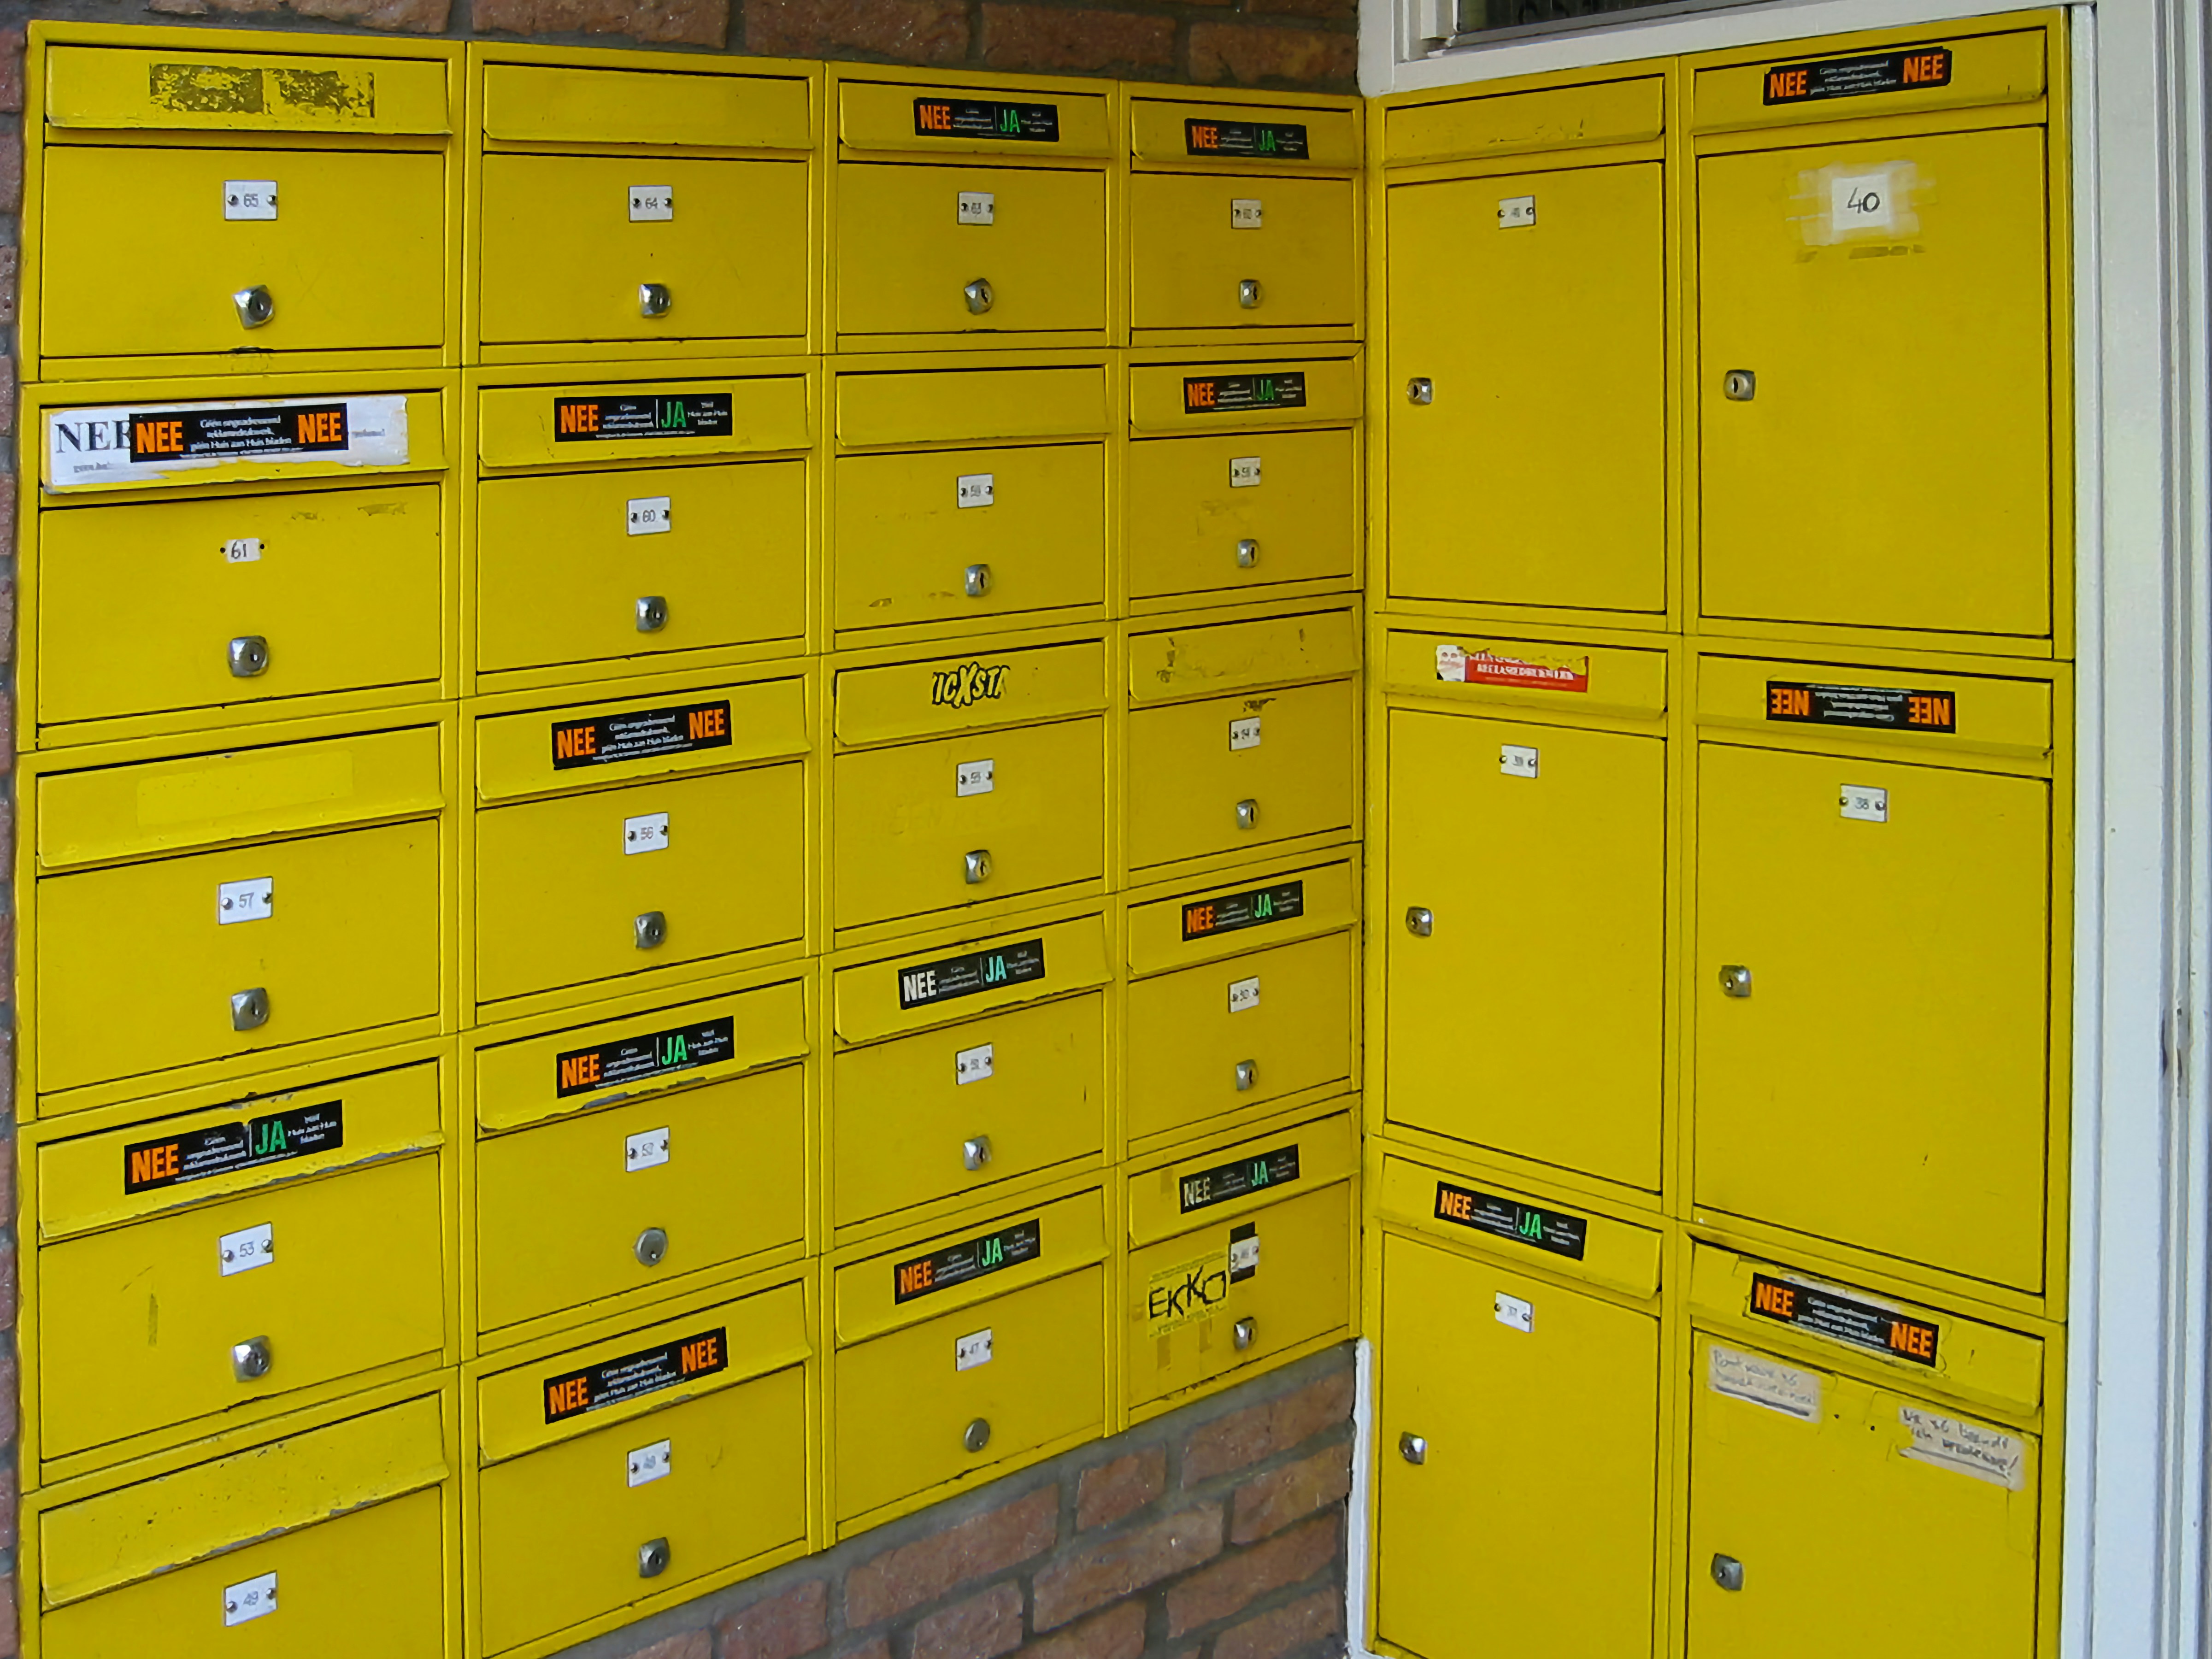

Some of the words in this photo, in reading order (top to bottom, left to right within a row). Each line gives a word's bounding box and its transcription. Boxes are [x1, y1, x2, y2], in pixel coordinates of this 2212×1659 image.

[1770, 70, 1807, 98] NEE
[1903, 53, 1944, 83] NEE
[920, 105, 951, 129] NEE
[1000, 109, 1020, 133] JA
[243, 193, 259, 207] 65
[645, 197, 658, 209] 64
[1847, 187, 1880, 214] 40
[1188, 382, 1216, 407] NEE
[136, 421, 183, 453] NEE
[298, 412, 342, 444] NEE
[561, 404, 599, 433] NEE
[661, 401, 687, 428] JA
[231, 539, 247, 559] 61
[1771, 688, 1810, 716] NEE
[1908, 696, 1950, 725] NEE
[557, 726, 596, 759] NEE
[688, 708, 725, 740] NEE
[239, 892, 254, 909] 57
[1186, 905, 1216, 933] NEE
[1255, 894, 1272, 918] JA
[903, 970, 937, 1002] NEE
[985, 955, 1007, 983] JA
[562, 1053, 600, 1089] NEE
[661, 1034, 688, 1065] JA
[131, 1143, 179, 1184] NEE
[255, 1120, 288, 1155] JA
[1251, 1160, 1270, 1187] JA
[1440, 1190, 1472, 1220] NEE
[1519, 1212, 1543, 1240] JA
[239, 1241, 255, 1258] 53
[900, 1260, 933, 1295] NEE
[982, 1237, 1004, 1267] JA
[1755, 1282, 1795, 1318] NEE
[1890, 1321, 1933, 1359] NEE
[548, 1377, 589, 1415] NEE
[681, 1336, 718, 1375] NEE
